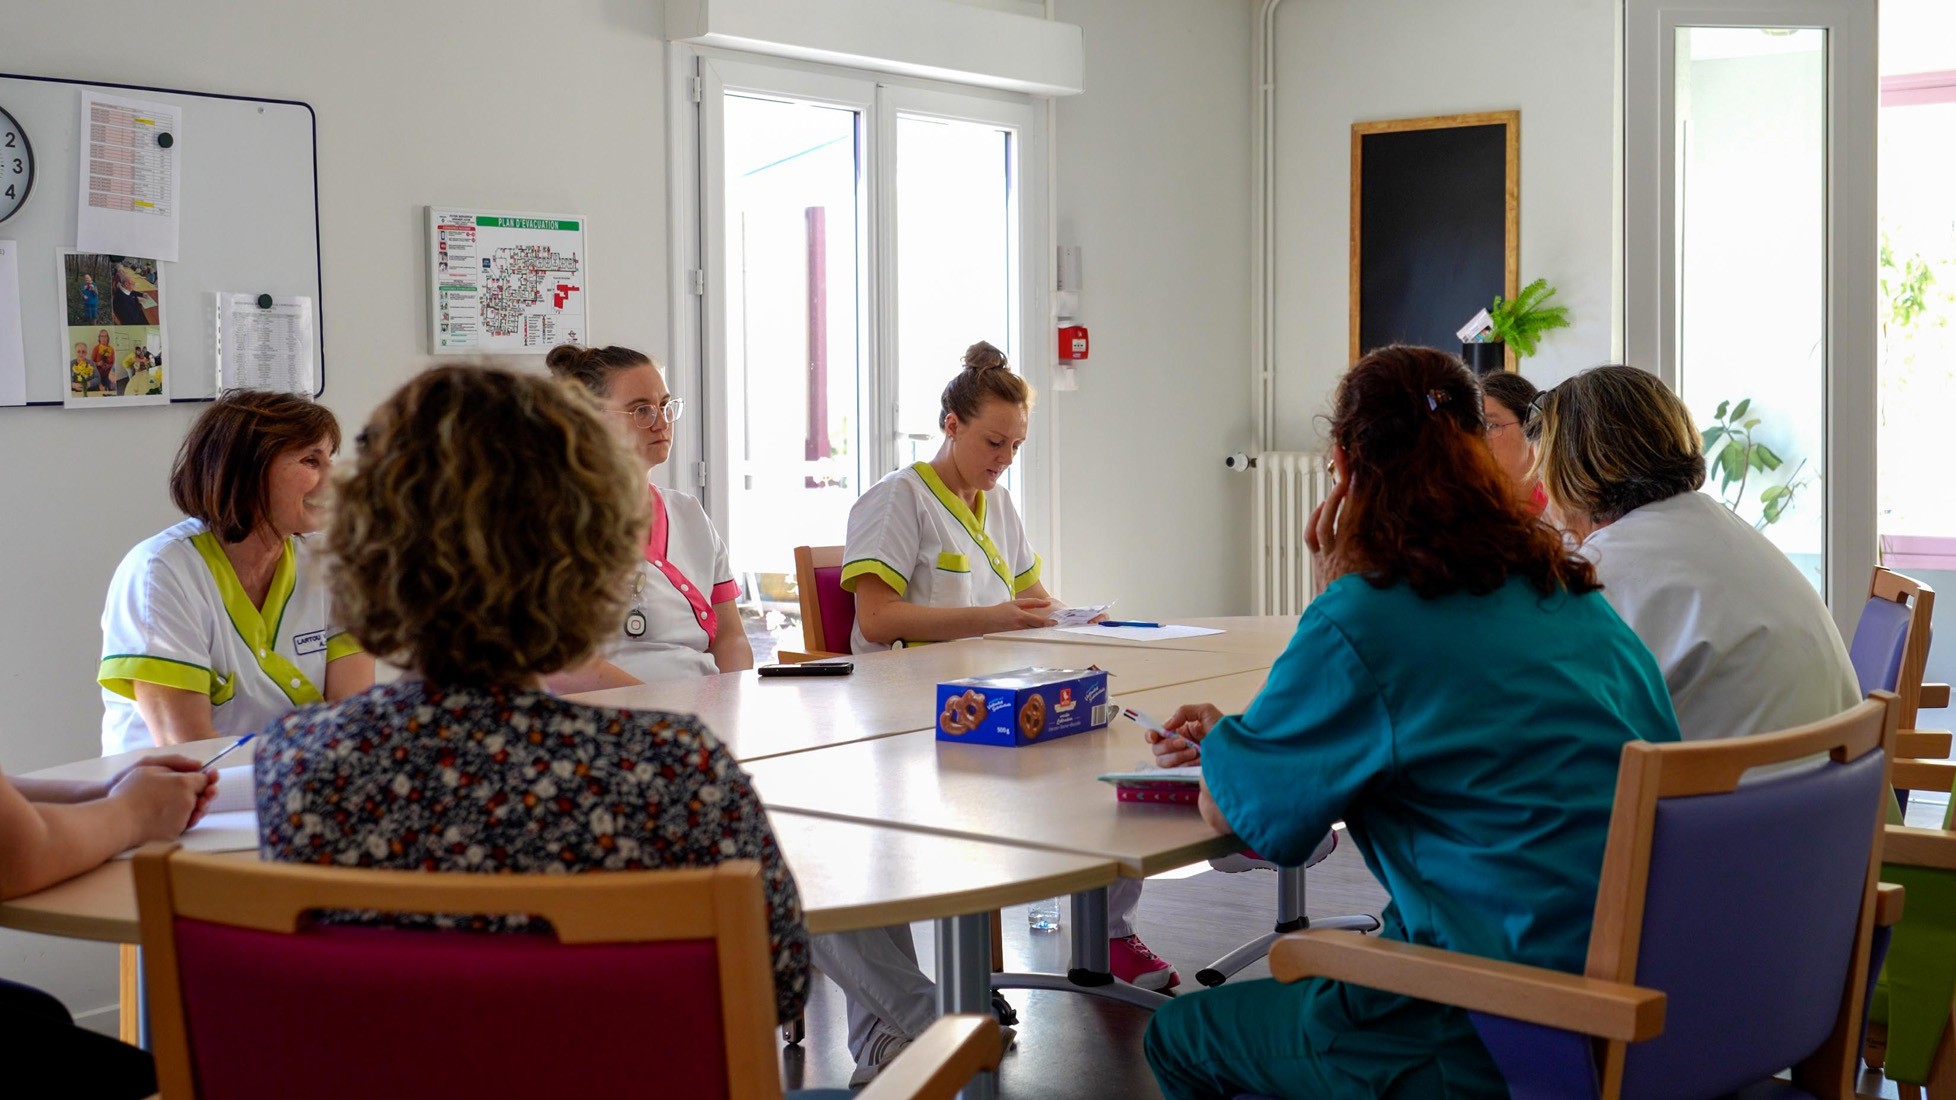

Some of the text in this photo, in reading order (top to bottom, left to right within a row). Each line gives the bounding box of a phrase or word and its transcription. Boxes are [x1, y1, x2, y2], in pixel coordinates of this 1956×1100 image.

[5, 132, 16, 148] 2
[12, 158, 23, 174] 3
[5, 184, 16, 200] 4
[498, 218, 515, 227] PLAN
